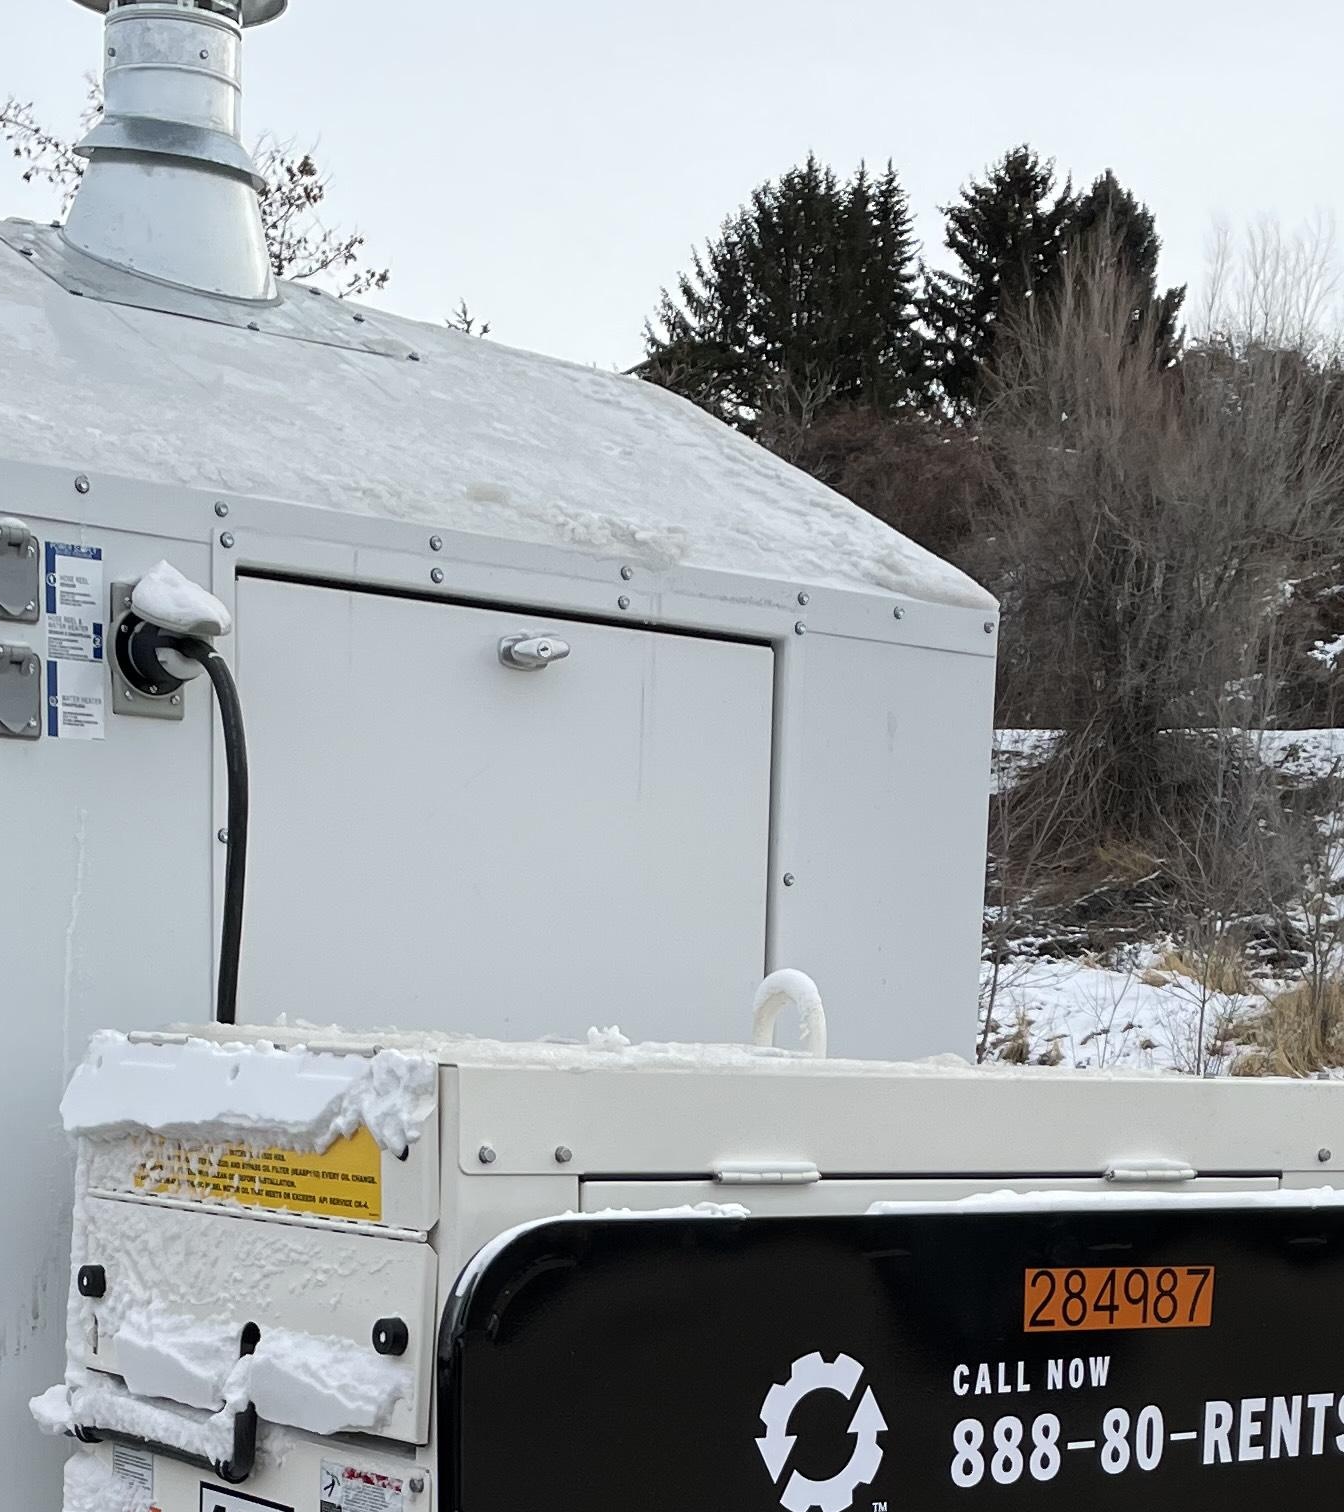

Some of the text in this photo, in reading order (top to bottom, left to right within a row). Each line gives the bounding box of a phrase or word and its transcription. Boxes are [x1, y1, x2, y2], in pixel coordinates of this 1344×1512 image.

[1029, 1268, 1211, 1327] 284987
[953, 1356, 1111, 1396] CALL NOW
